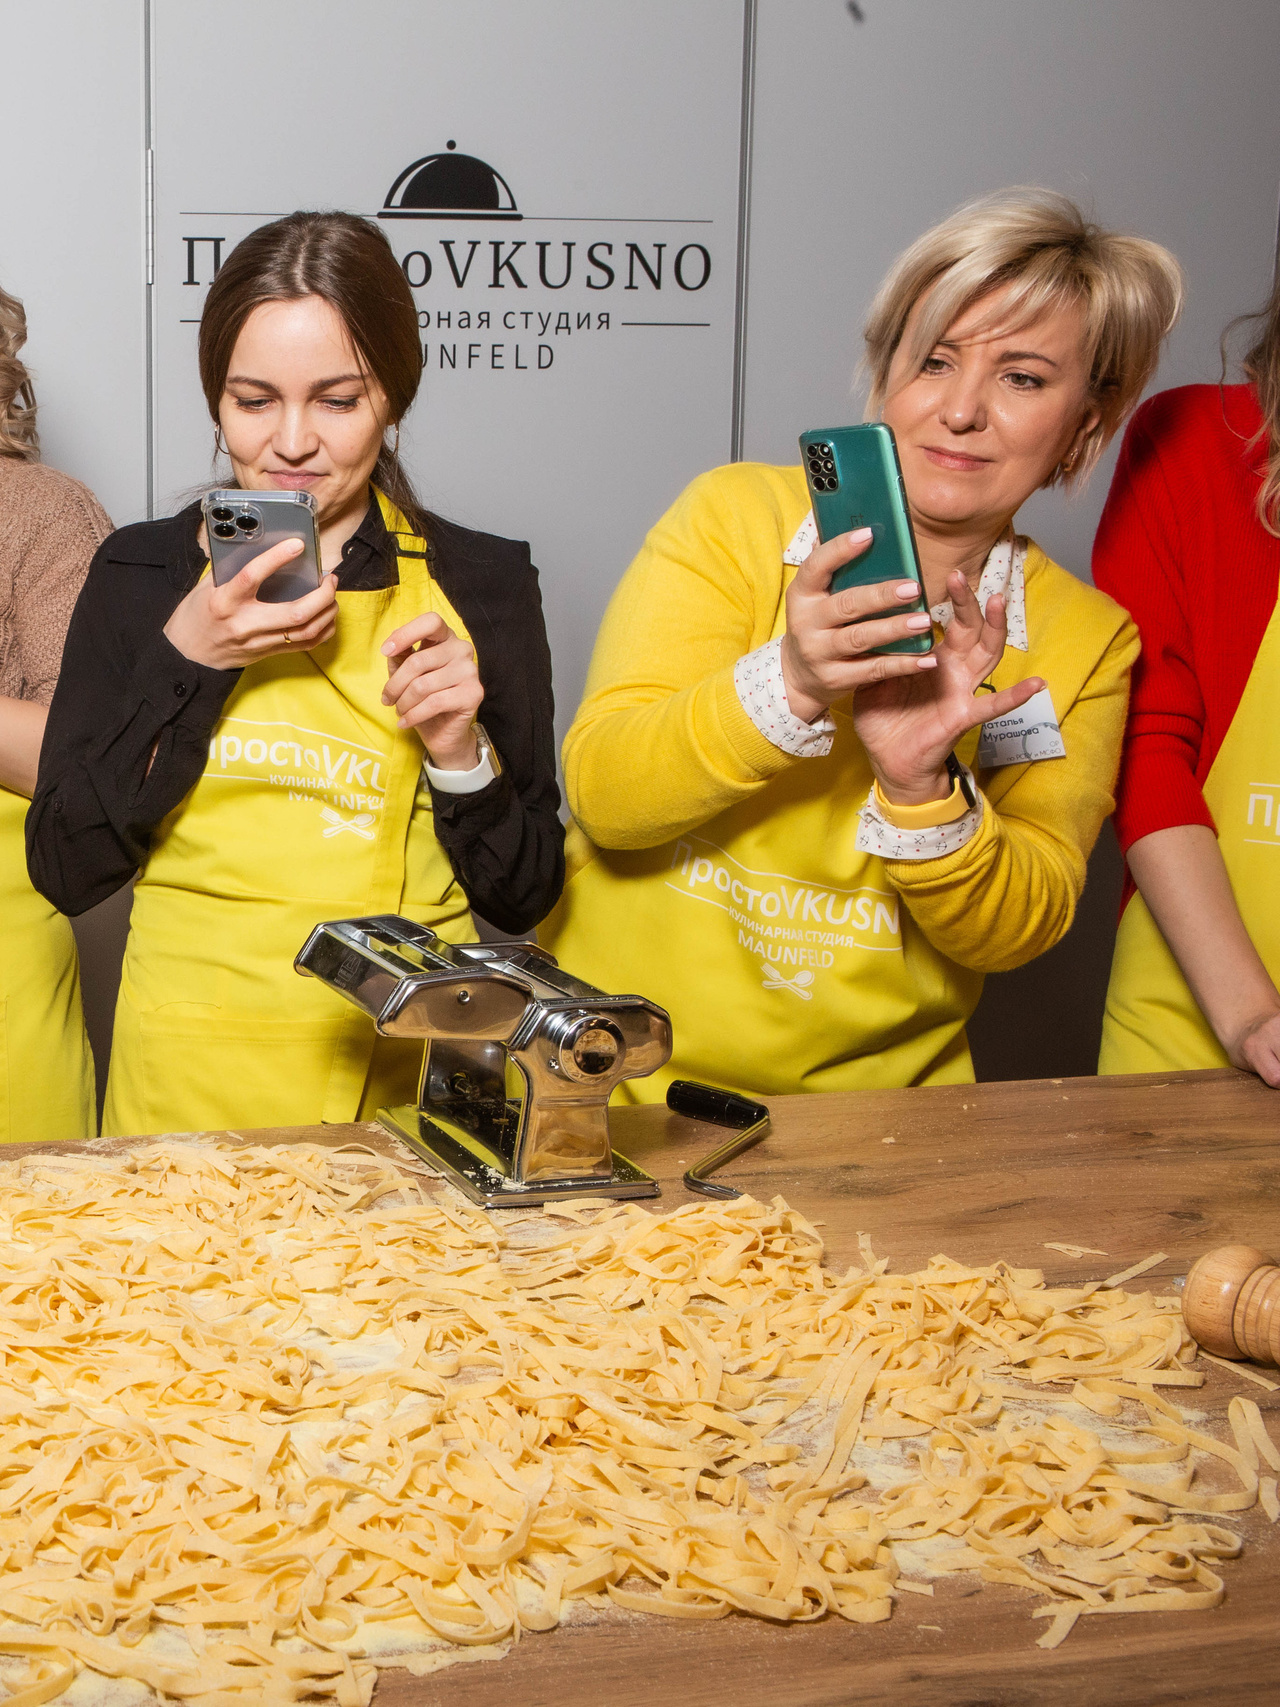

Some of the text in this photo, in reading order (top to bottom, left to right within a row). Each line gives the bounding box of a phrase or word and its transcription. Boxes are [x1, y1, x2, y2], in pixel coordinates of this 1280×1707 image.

[182, 236, 712, 291] ПоVKUSNO
[503, 311, 611, 337] студия
[983, 727, 1040, 742] Мурашова
[671, 839, 899, 935] ПростоVKUSN
[728, 905, 854, 948] КУЛИНАРНАЯ СТУДИЯ
[738, 928, 835, 969] MAUNFELD
